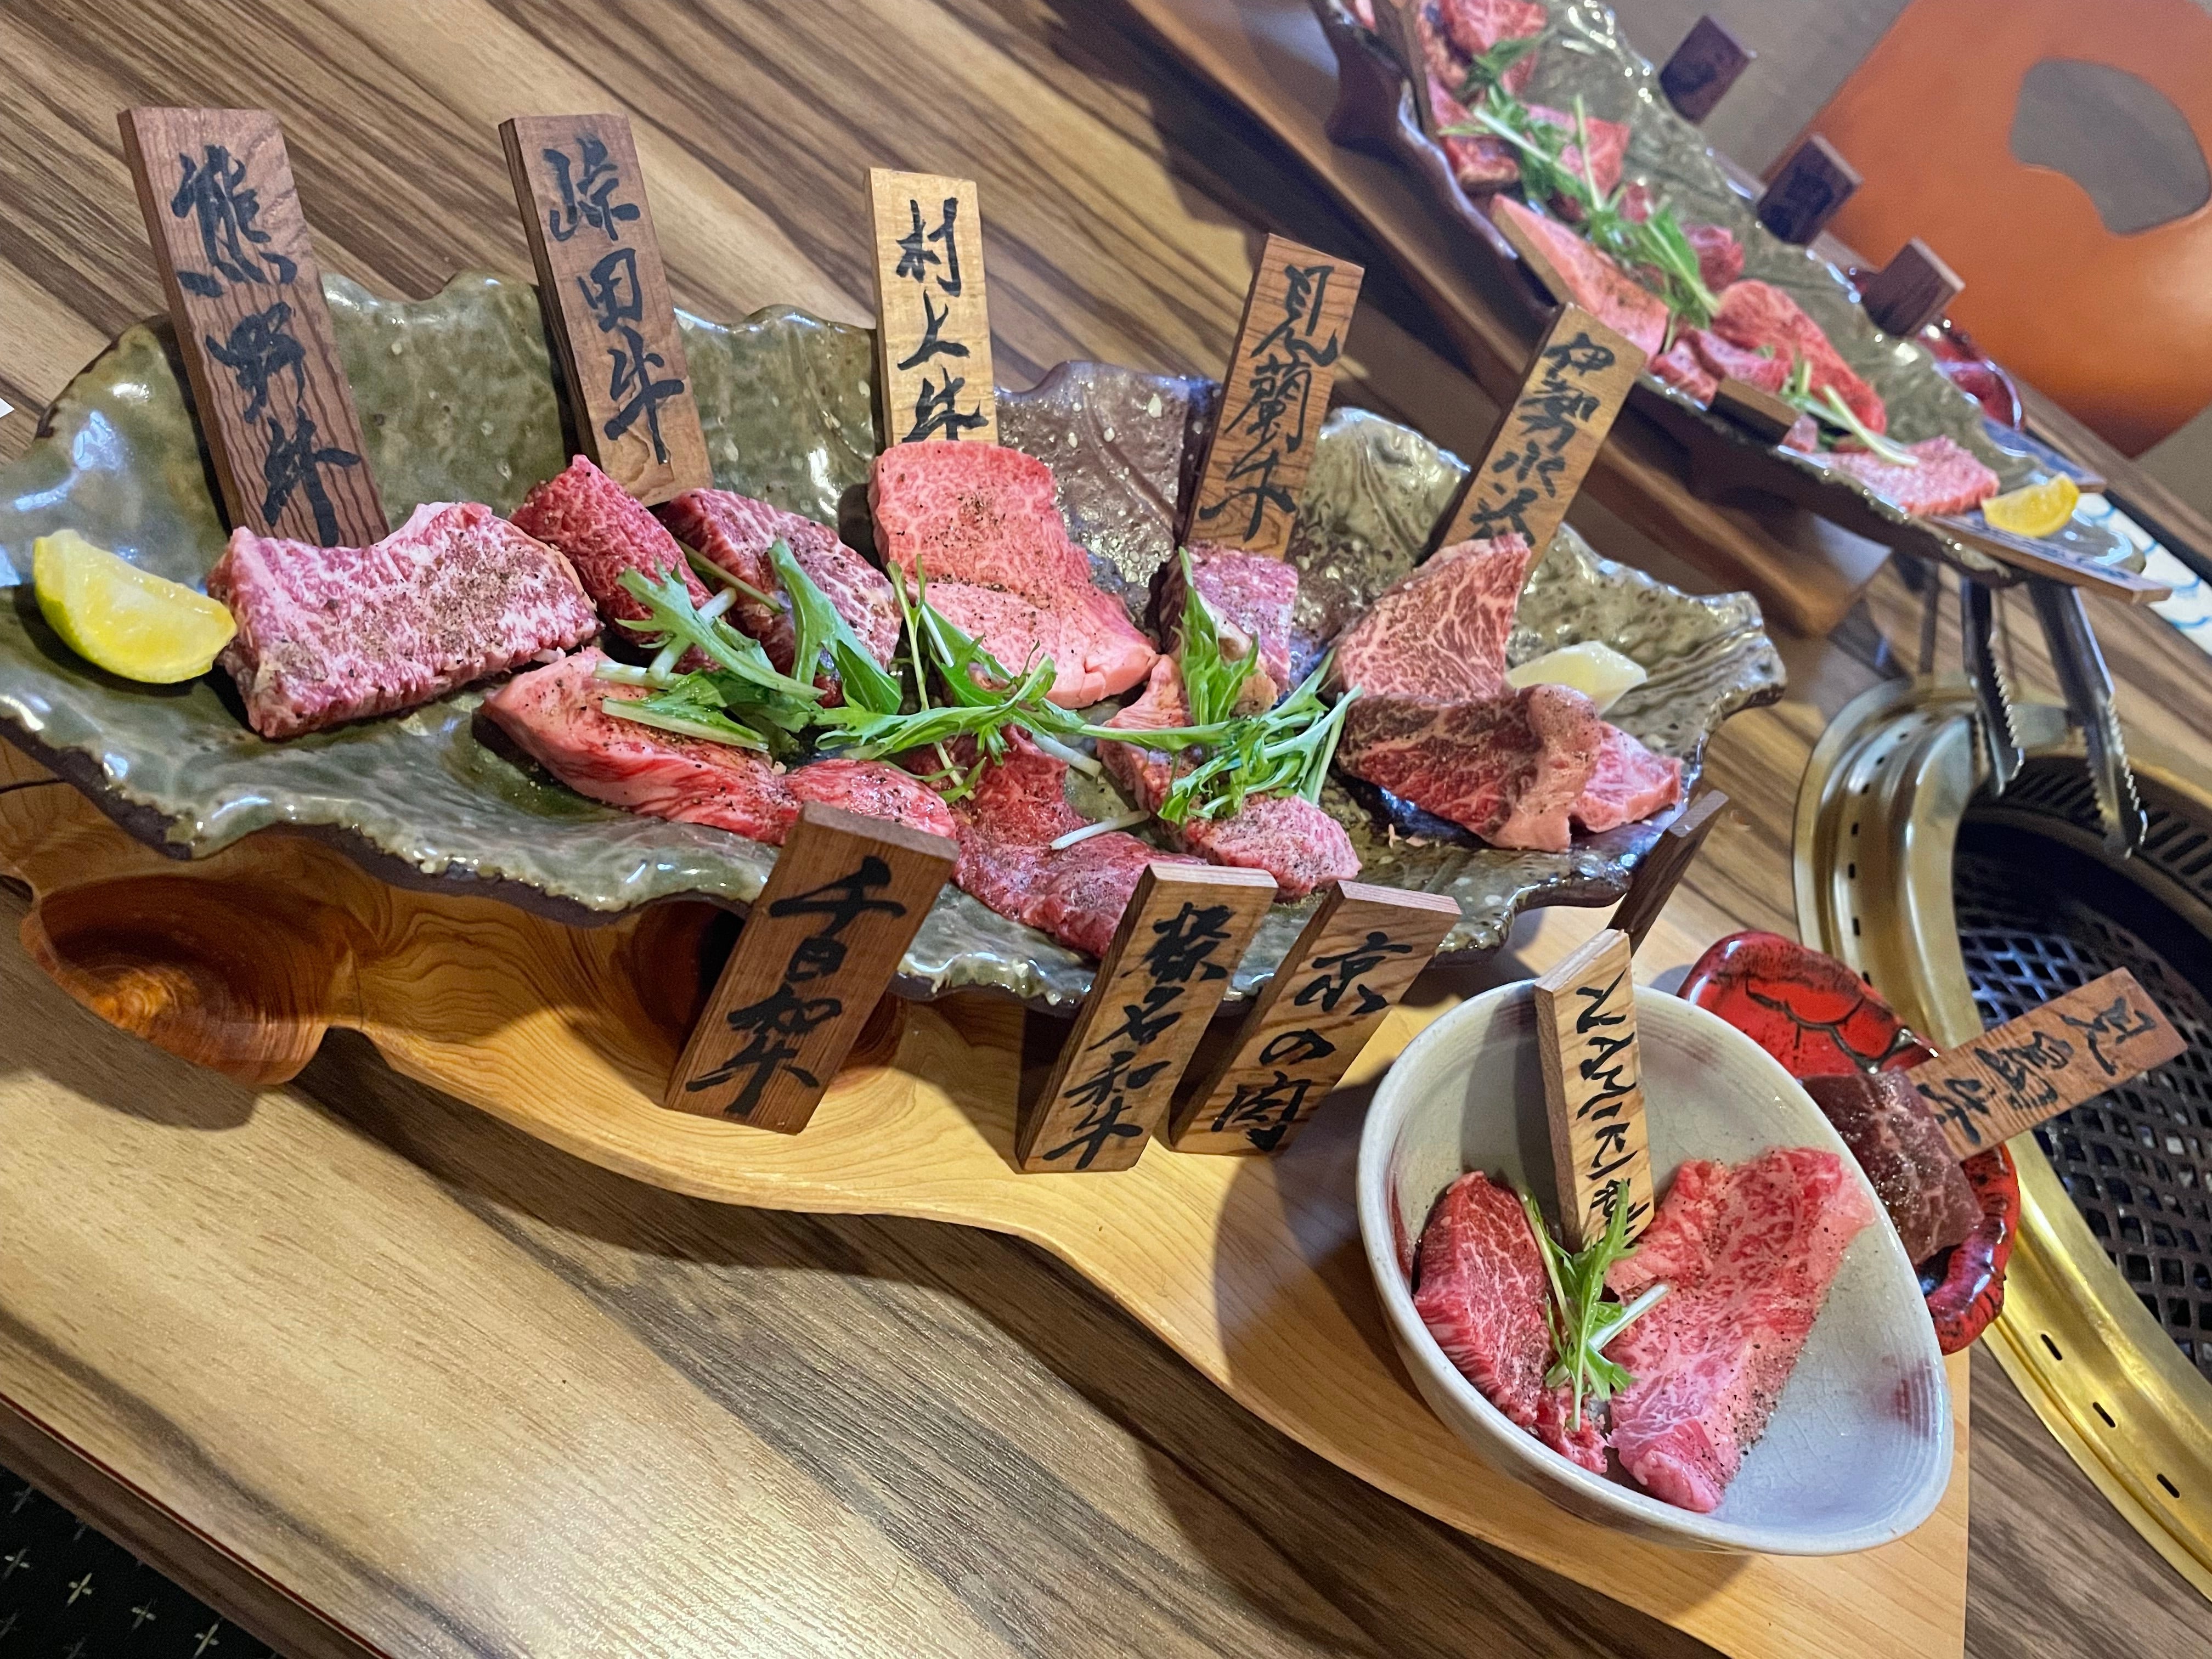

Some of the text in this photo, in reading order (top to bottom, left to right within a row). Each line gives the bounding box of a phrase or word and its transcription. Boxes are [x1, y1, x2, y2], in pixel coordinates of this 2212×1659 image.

[895, 196, 989, 442] 村上牛
[1199, 264, 1338, 543] 見蘭牛
[1211, 931, 1413, 1152] 京の肉
[1916, 995, 2157, 1146] 見島牛
